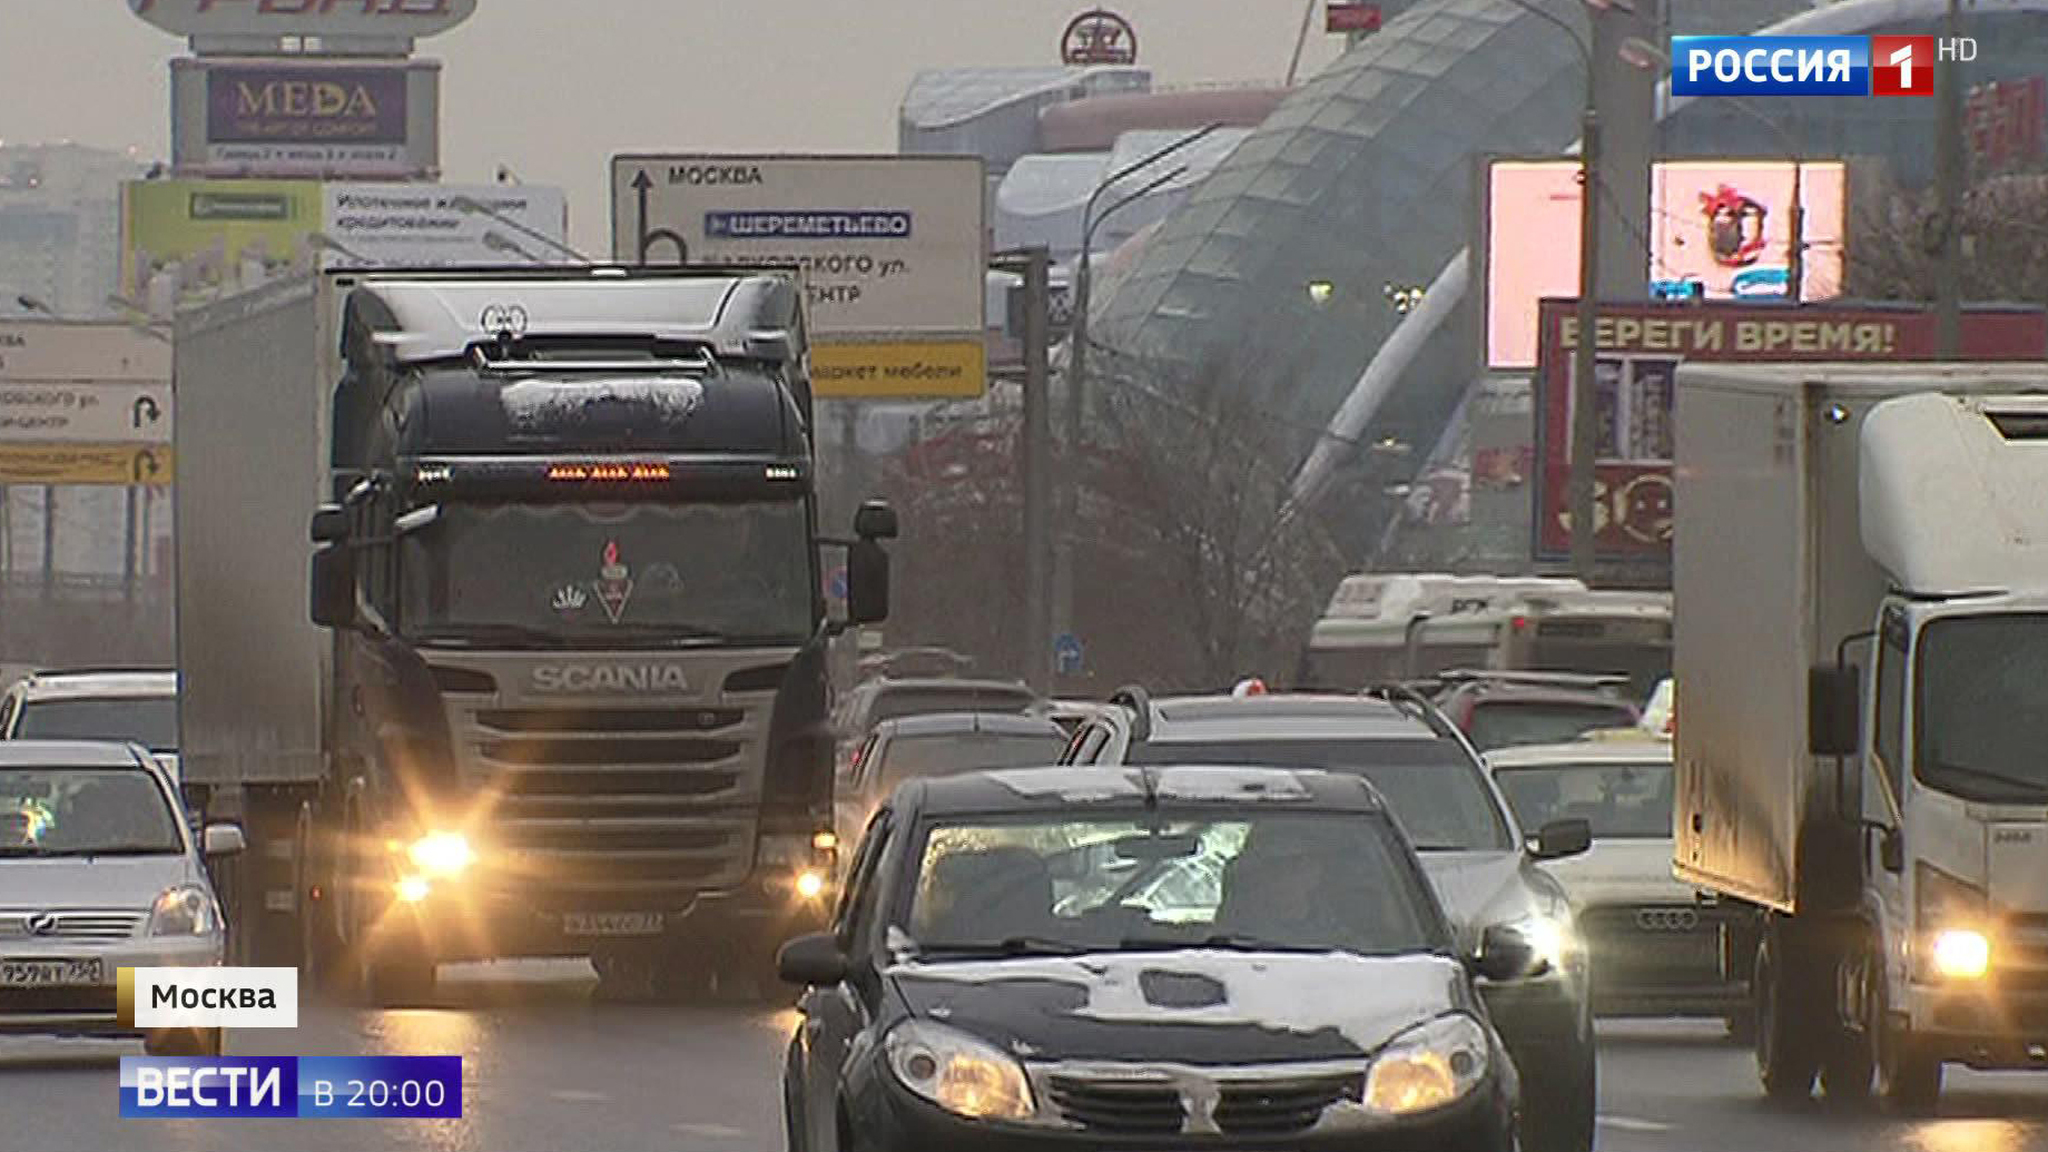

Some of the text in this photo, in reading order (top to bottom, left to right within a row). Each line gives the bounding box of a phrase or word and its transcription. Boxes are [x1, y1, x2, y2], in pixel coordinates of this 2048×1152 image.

[237, 80, 377, 116] MEDA
[668, 166, 763, 186] МОСКВА
[730, 216, 908, 235] ШЕРЕМЕТЬЕВО
[1736, 322, 1895, 353] ВРЕМЯ!
[533, 661, 689, 693] SCANIA
